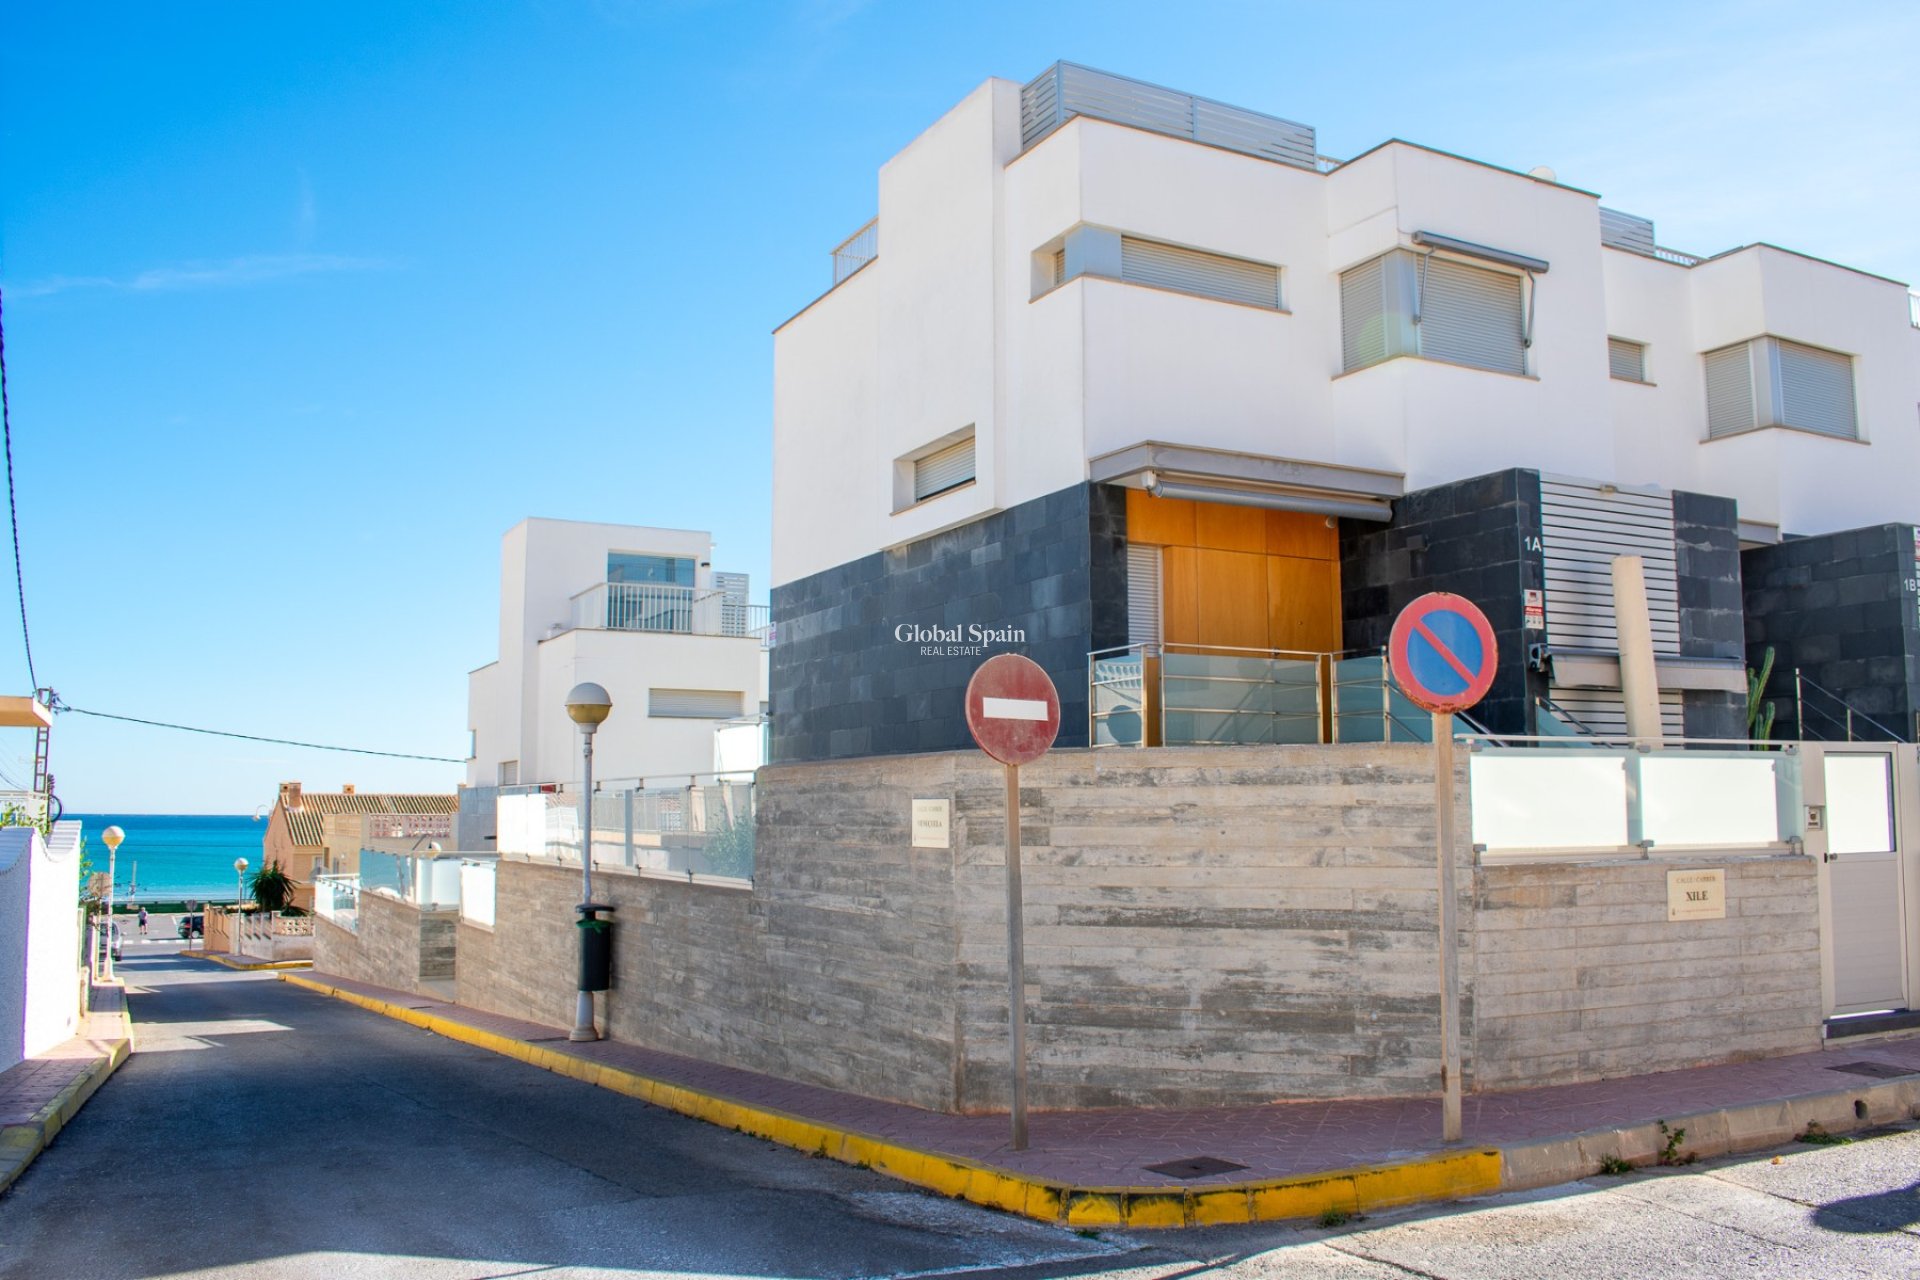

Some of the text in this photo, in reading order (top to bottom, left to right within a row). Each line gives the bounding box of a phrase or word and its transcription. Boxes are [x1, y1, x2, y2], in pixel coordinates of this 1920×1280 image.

[1524, 536, 1542, 552] 1A
[1904, 578, 1916, 592] 1B
[1686, 890, 1708, 902] XILE
